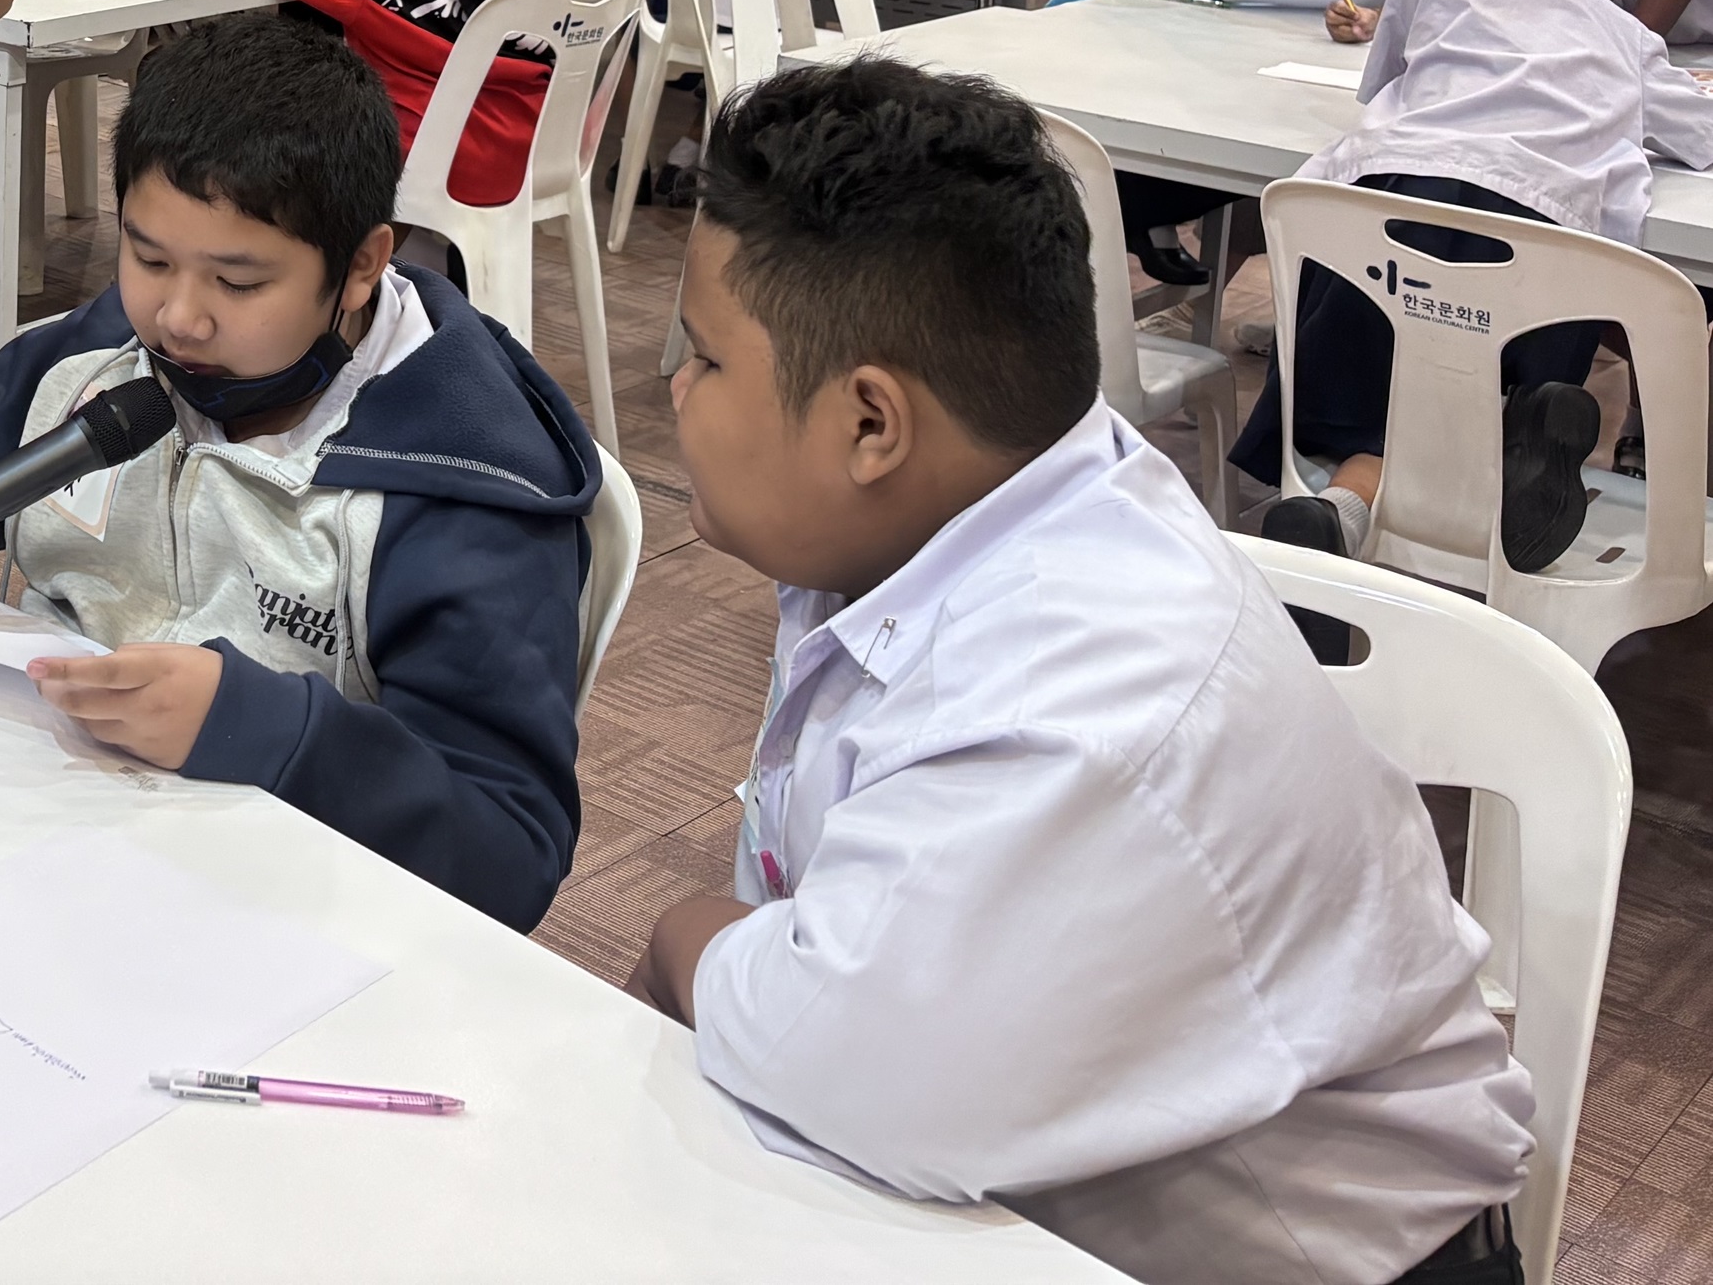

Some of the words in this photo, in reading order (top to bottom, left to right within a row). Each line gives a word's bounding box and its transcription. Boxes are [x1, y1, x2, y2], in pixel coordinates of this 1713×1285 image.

[1402, 293, 1491, 327] 한국문화원
[1404, 311, 1431, 322] KOREAN
[1431, 317, 1464, 330] CULTURAL
[1464, 325, 1490, 335] CENTER
